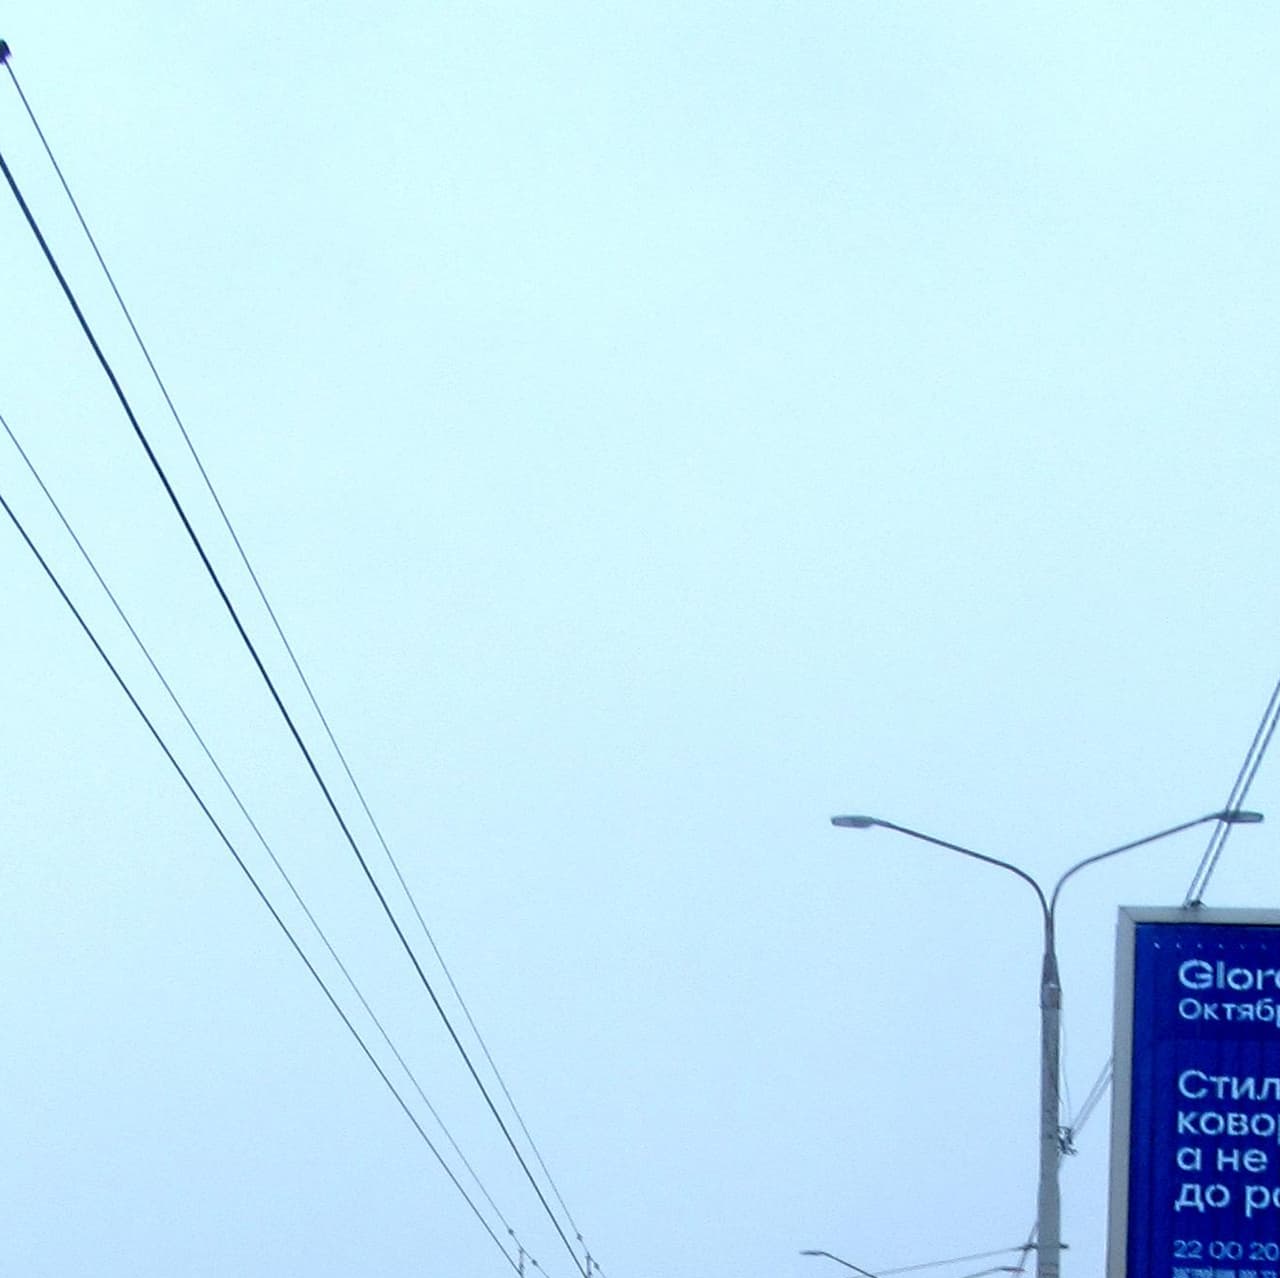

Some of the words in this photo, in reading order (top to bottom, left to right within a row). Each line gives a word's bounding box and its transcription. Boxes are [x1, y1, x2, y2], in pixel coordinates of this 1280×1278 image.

[1176, 1147, 1202, 1171] а
[1217, 1148, 1268, 1173] не
[1174, 1183, 1230, 1213] до
[1173, 1239, 1203, 1259] 22
[1209, 1240, 1244, 1260] 00
[1248, 1242, 1280, 1262] 20
